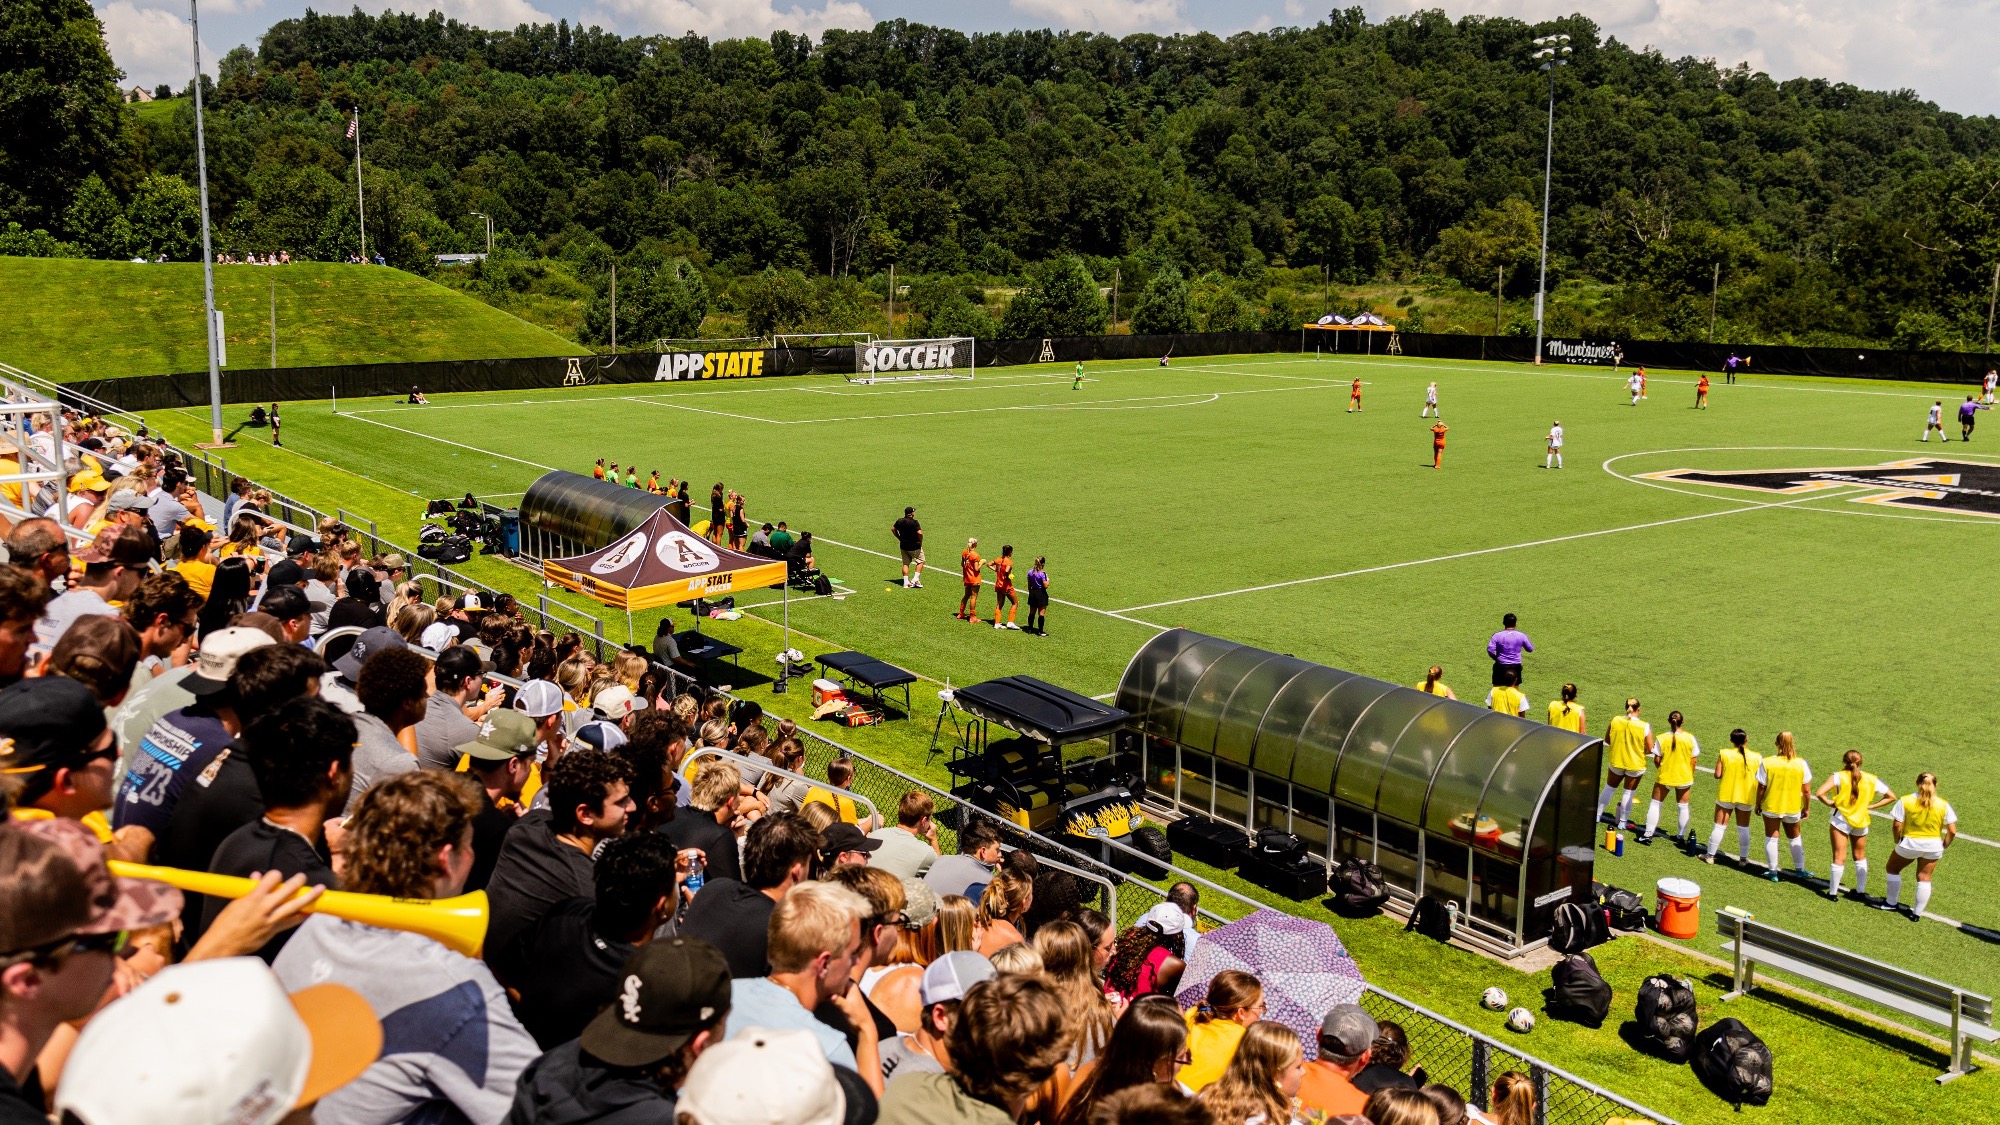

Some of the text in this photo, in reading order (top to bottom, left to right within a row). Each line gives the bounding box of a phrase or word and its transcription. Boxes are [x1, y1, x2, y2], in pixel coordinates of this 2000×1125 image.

[862, 346, 956, 372] SOCCER
[1039, 338, 1055, 362] A
[563, 358, 586, 386] A
[674, 540, 705, 562] A
[704, 583, 733, 595] SOCCER
